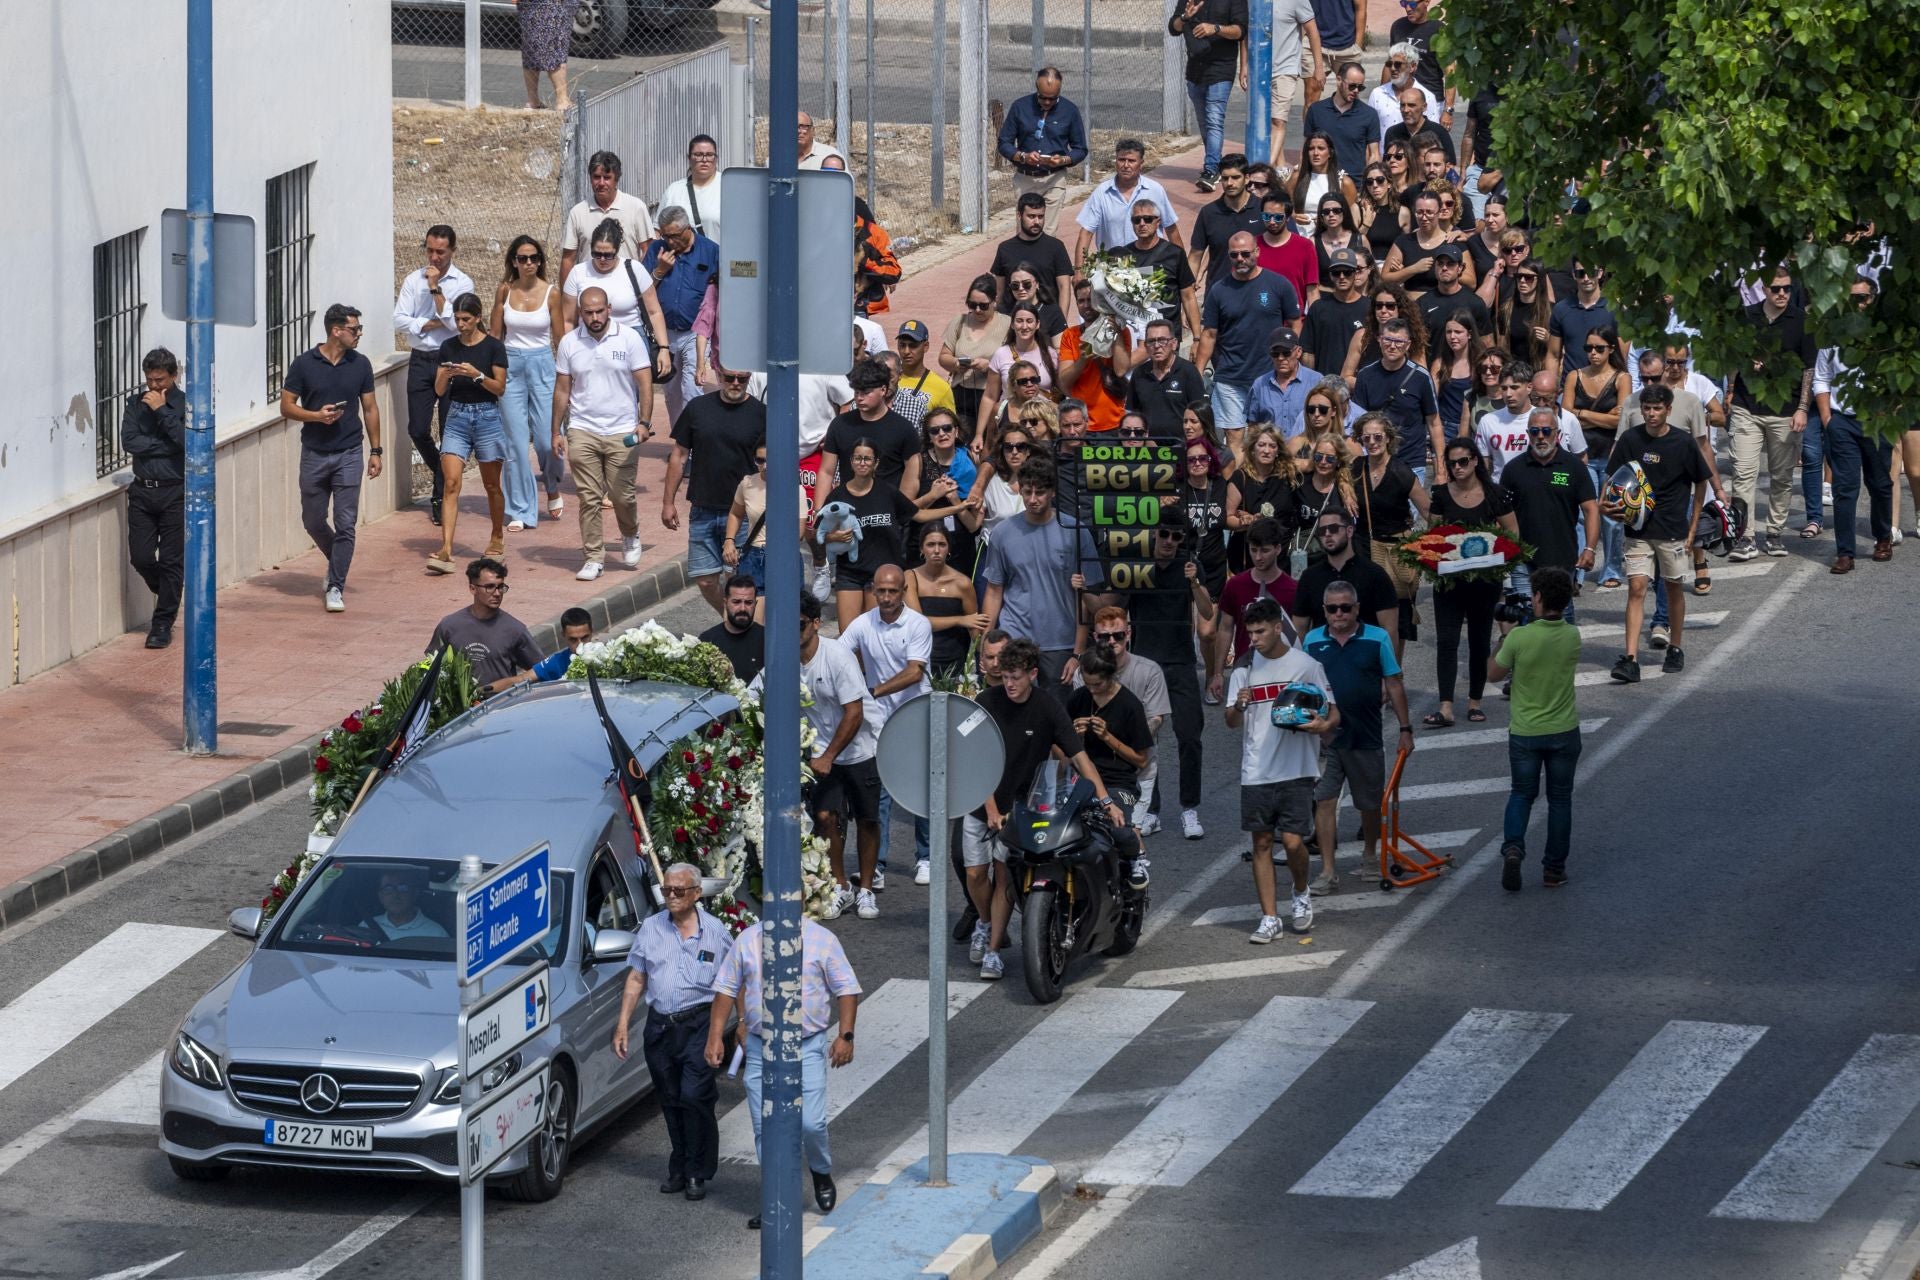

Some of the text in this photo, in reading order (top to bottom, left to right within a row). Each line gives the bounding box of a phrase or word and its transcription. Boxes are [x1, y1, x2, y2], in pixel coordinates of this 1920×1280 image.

[1082, 446, 1178, 460] BORJA G.
[1086, 464, 1175, 492] BG12
[1094, 495, 1160, 525] L50
[1109, 529, 1150, 557] P1
[1111, 563, 1155, 589] OK
[489, 872, 528, 911] Santomera
[468, 912, 519, 963] AP-7 Alicante
[468, 1013, 501, 1058] hospital
[278, 1125, 367, 1147] 8727 MGW
